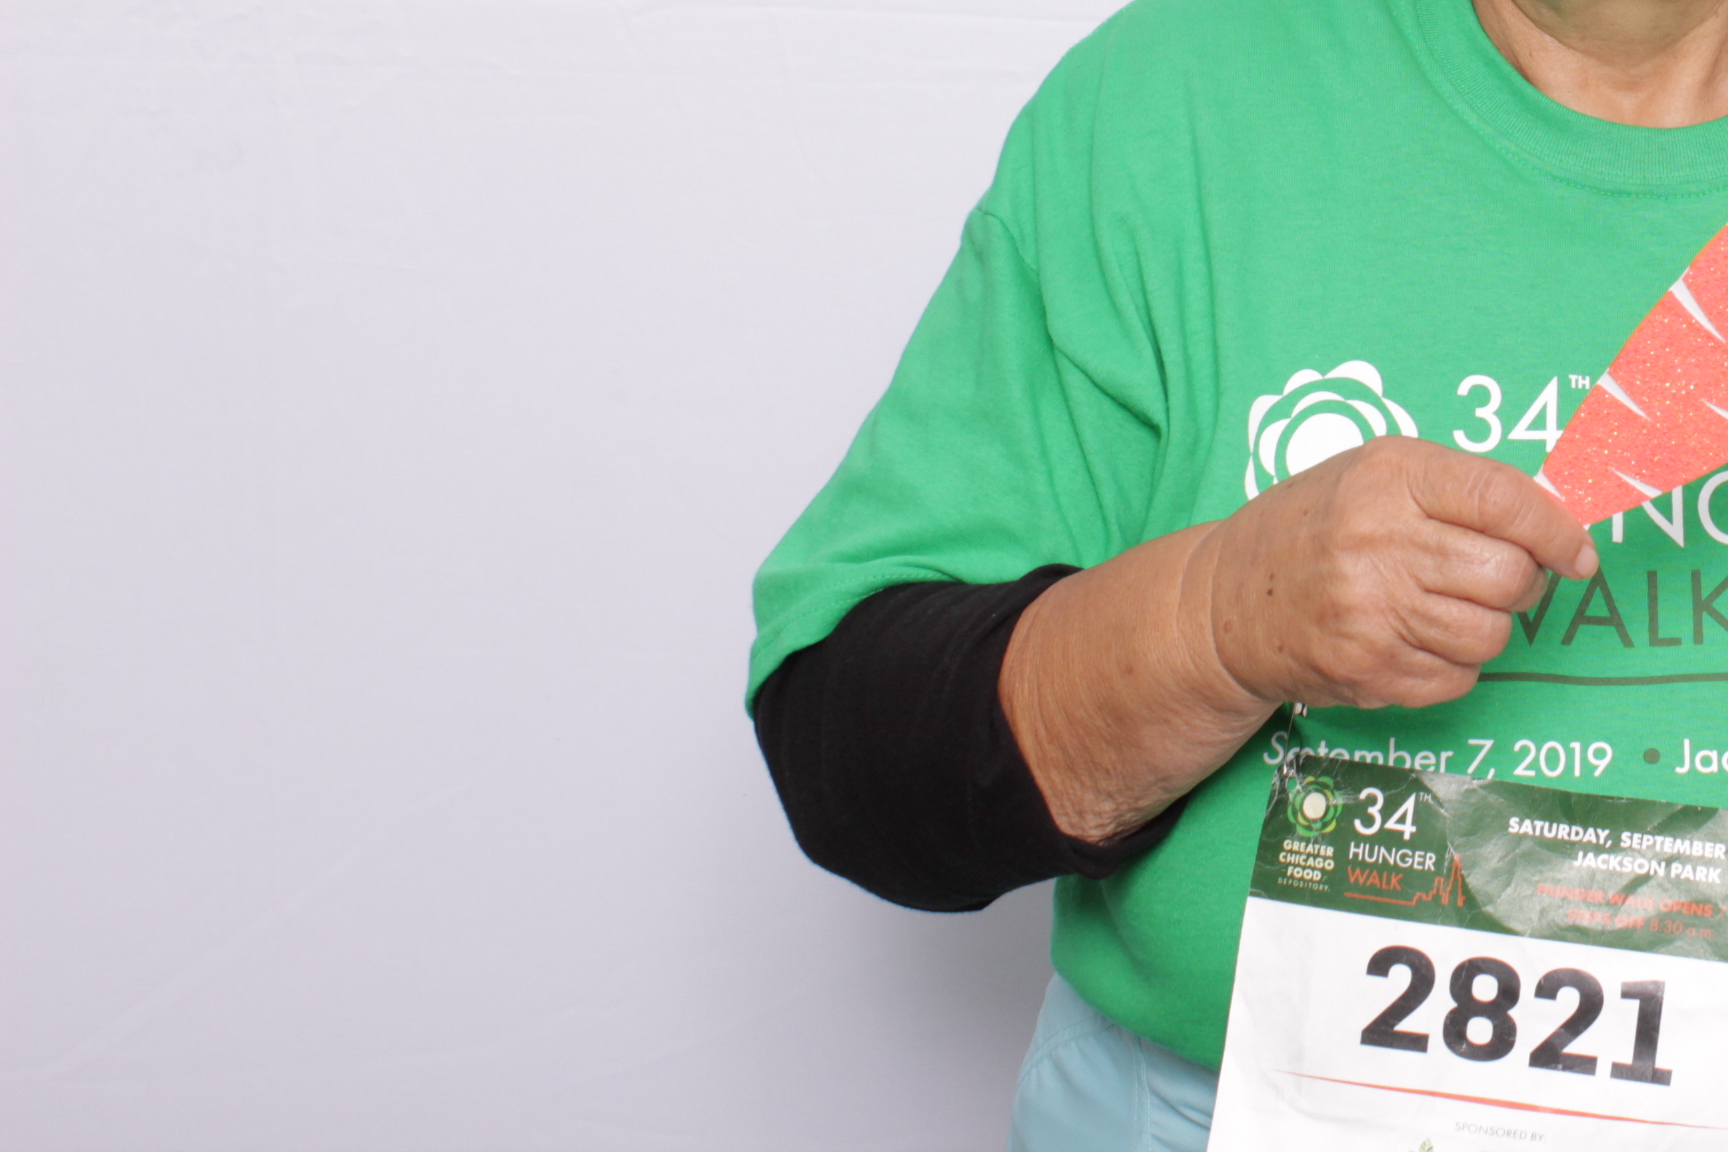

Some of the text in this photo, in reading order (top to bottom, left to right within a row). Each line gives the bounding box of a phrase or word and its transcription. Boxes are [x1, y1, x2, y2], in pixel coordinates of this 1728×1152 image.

[1466, 738, 1496, 780] 7,
[1513, 739, 1613, 778] 2019
[1283, 839, 1335, 857] GREATER
[1507, 817, 1613, 849] SATURDAY,
[1619, 831, 1726, 860] SEPTEMBER
[1278, 851, 1335, 871] CHICAGO
[1349, 841, 1436, 872] HUNGER
[1573, 851, 1723, 884] JACKSON PARK
[1286, 865, 1323, 881] FOOD
[1347, 866, 1404, 891] WALK
[1536, 882, 1605, 904] HUNGER
[1609, 892, 1656, 910] WALK
[1659, 898, 1713, 918] OPENS
[1615, 915, 1647, 930] OFF
[1650, 918, 1684, 935] 8:30
[1686, 926, 1715, 939] a.m.
[1360, 944, 1673, 1087] 2821
[1455, 1121, 1528, 1141] SPONSORED
